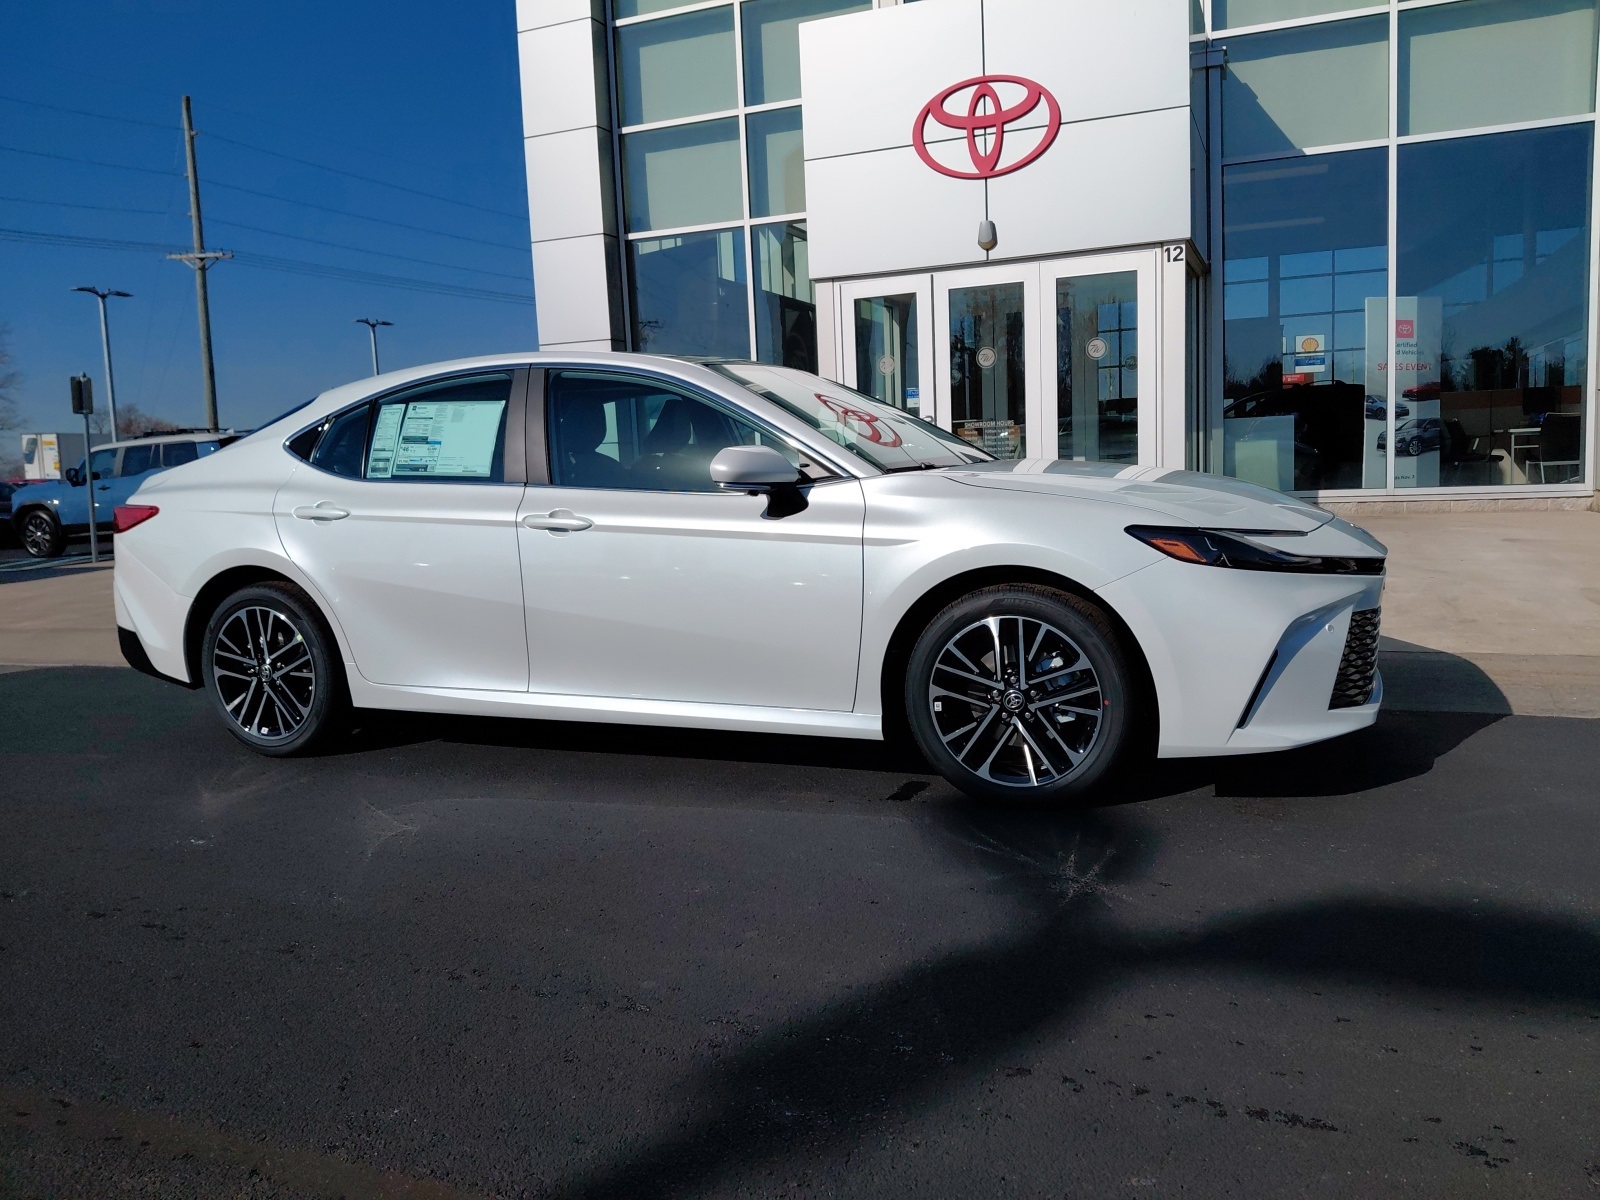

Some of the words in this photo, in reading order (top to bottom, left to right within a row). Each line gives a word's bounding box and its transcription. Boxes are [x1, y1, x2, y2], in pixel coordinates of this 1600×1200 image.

[1164, 245, 1184, 263] 12
[1377, 362, 1404, 371] SAES
[1405, 362, 1433, 371] EVENT
